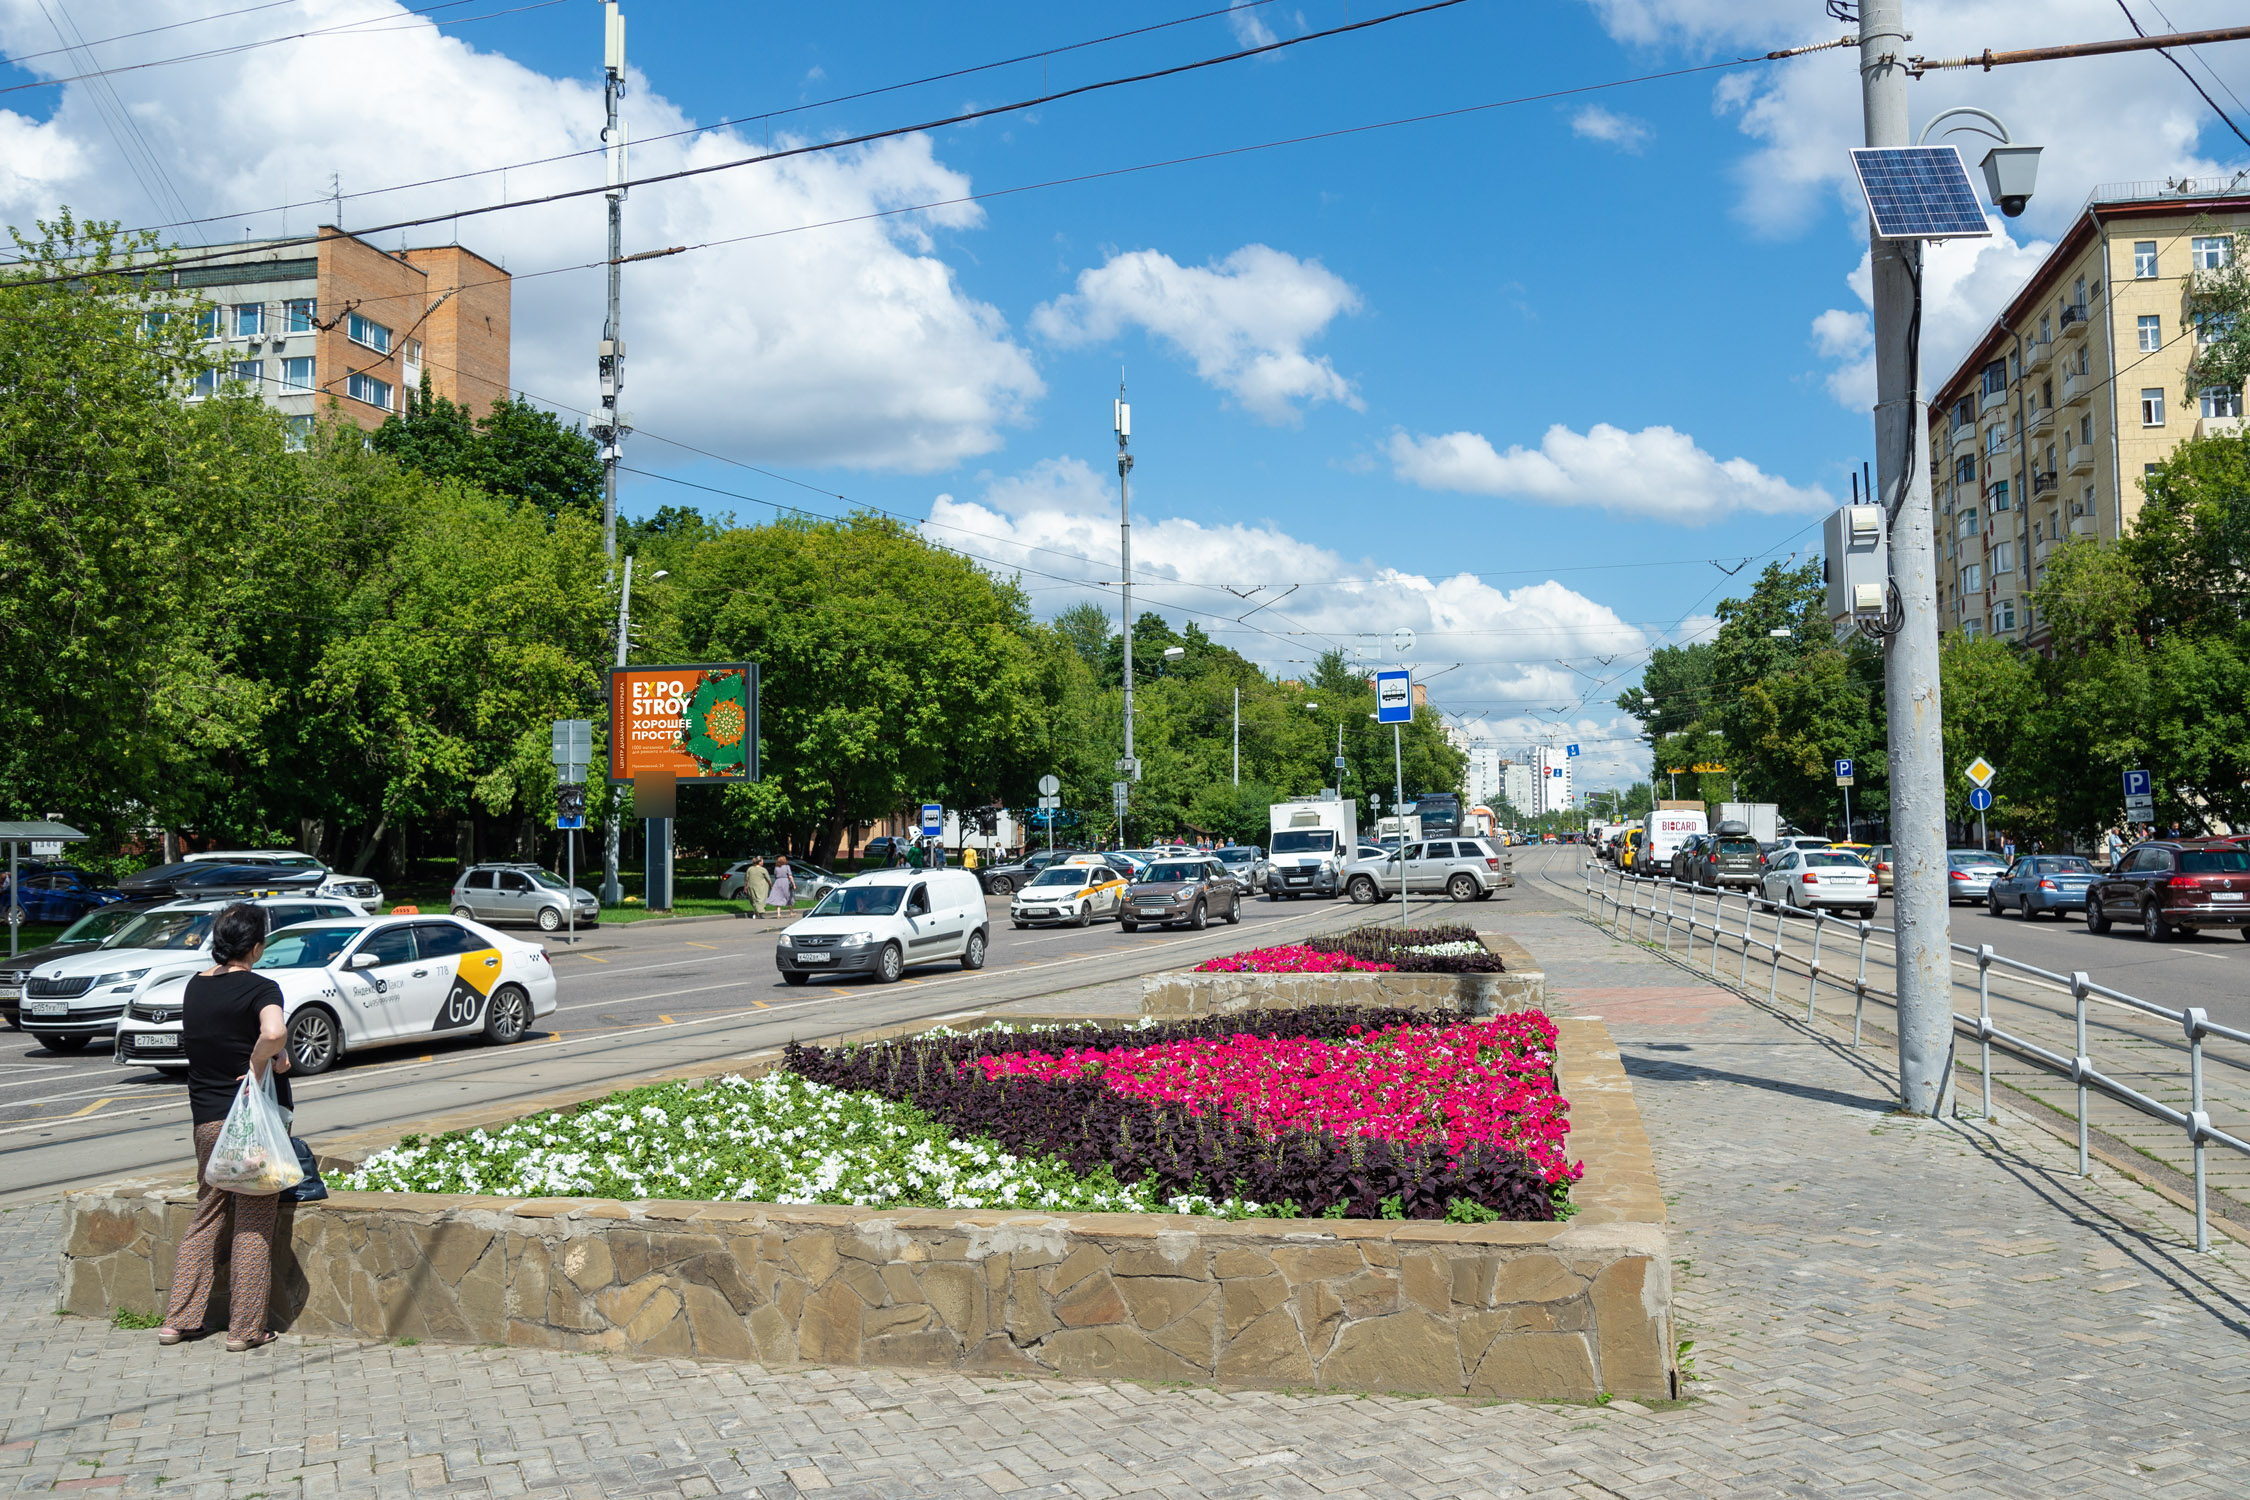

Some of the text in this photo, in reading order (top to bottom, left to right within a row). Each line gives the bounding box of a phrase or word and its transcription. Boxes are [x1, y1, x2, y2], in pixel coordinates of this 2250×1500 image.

[632, 681, 684, 698] EXPO
[632, 698, 692, 716] STROY
[632, 719, 693, 730] ХОРОШЕЕ
[631, 730, 683, 741] ПРОСТО
[1840, 761, 1849, 775] P
[2129, 773, 2144, 794] P
[436, 966, 449, 977] 778
[377, 980, 387, 993] Go
[449, 987, 476, 1023] Go
